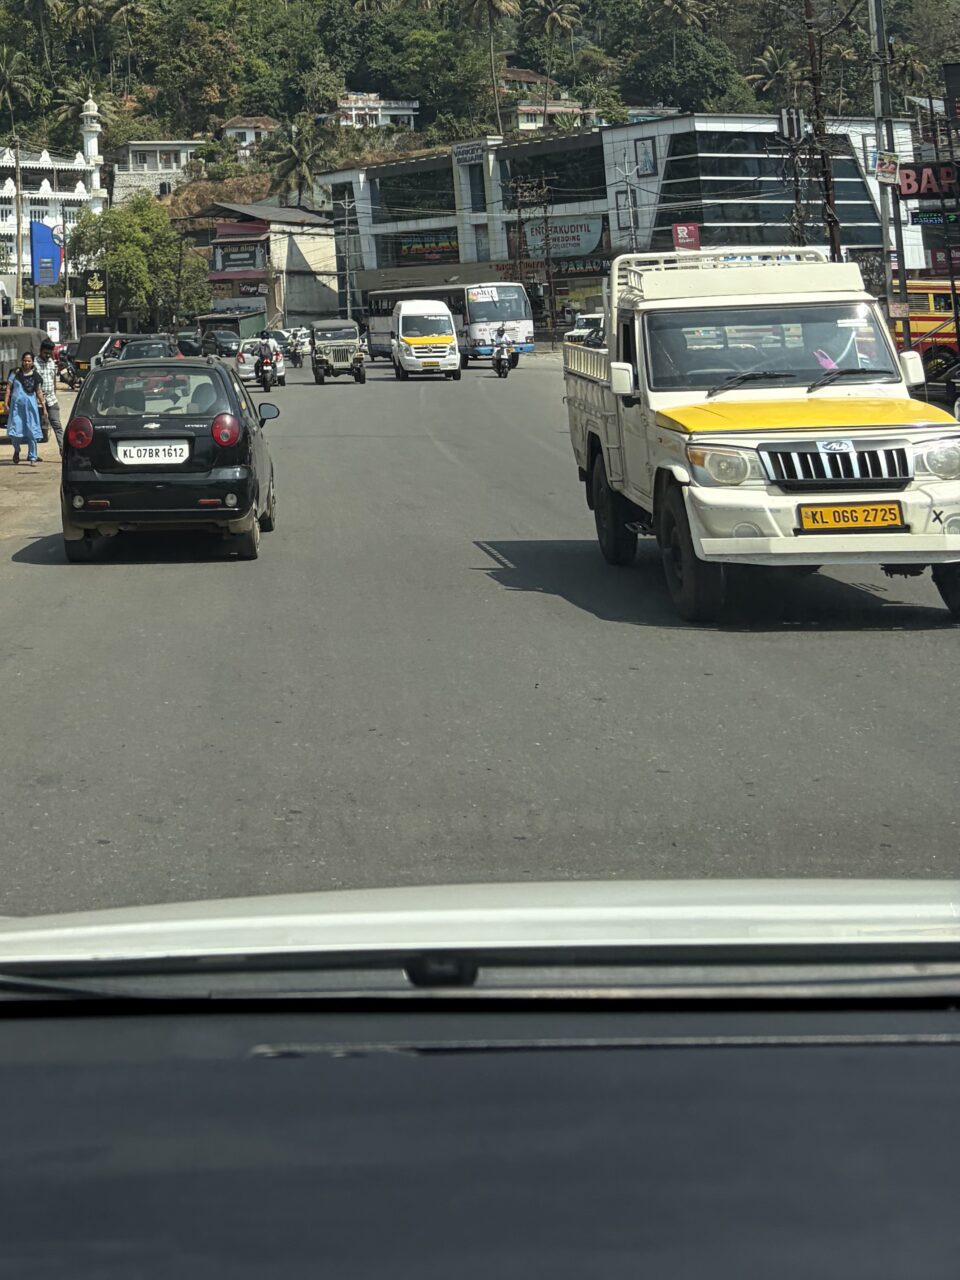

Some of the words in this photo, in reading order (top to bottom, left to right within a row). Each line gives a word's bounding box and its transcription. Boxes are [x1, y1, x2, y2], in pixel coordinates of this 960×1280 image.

[123, 449, 134, 459] KL
[162, 447, 185, 458] 1612
[811, 510, 829, 524] KL
[863, 507, 897, 522] 2725
